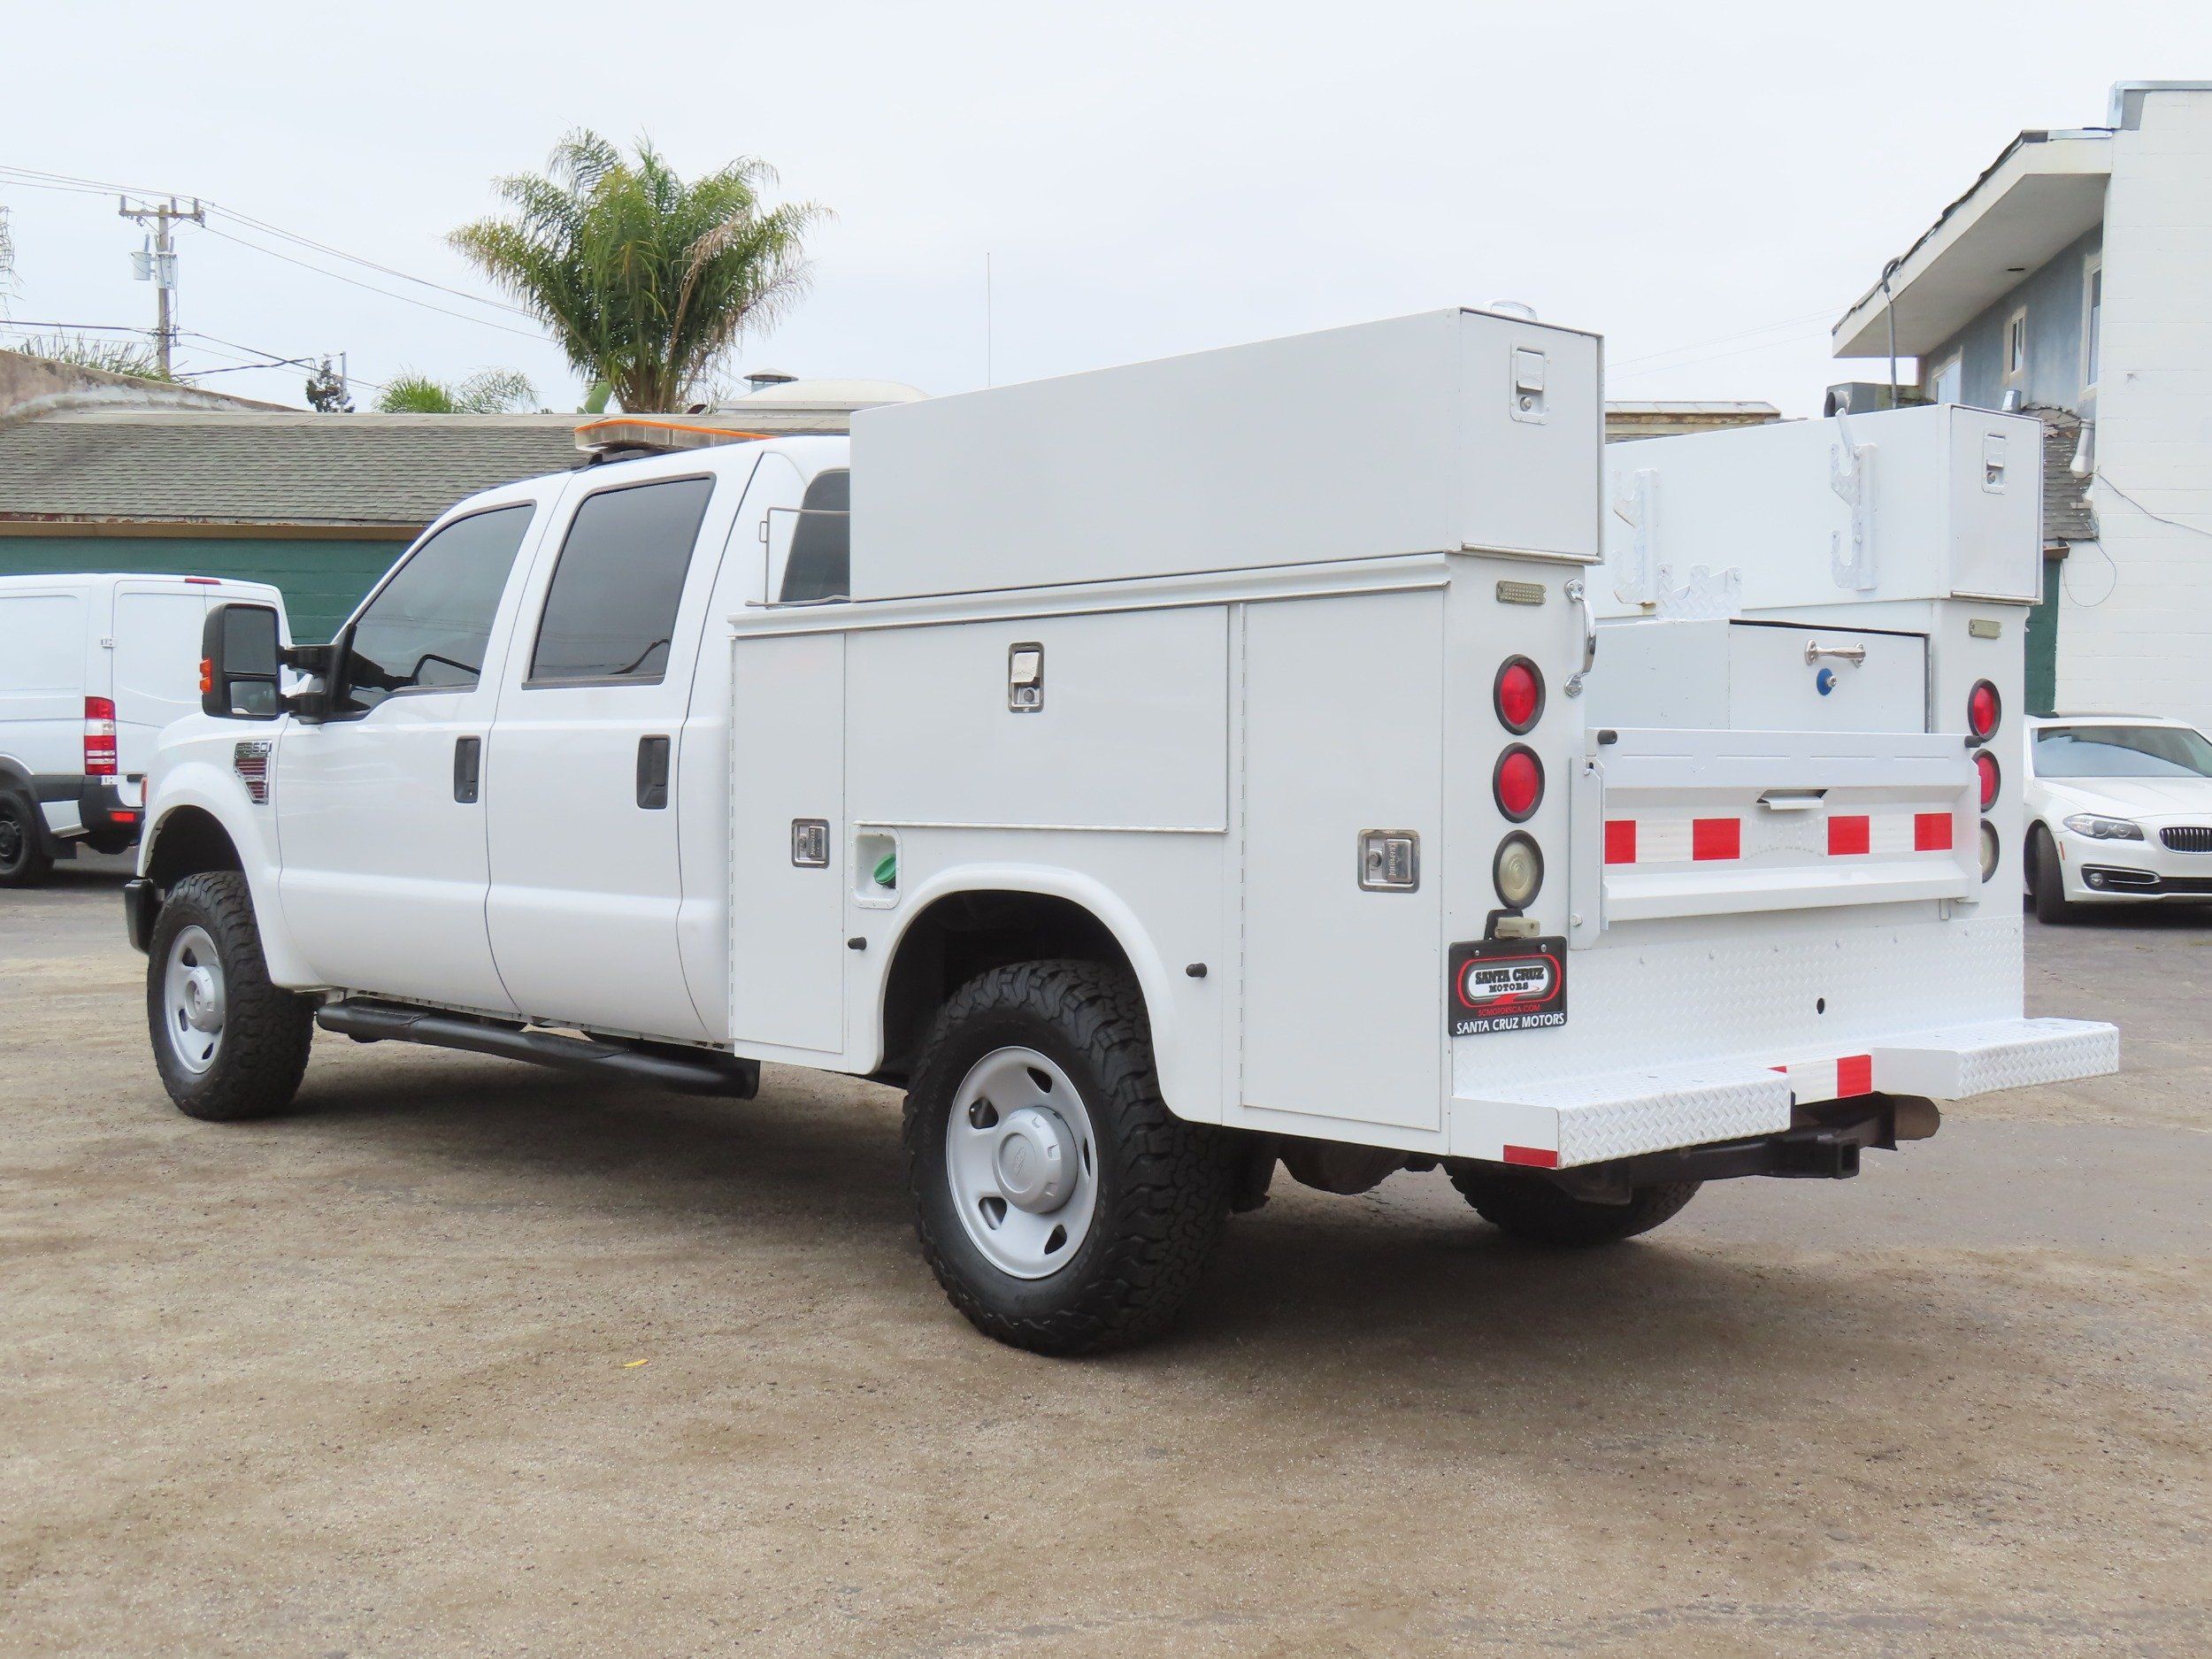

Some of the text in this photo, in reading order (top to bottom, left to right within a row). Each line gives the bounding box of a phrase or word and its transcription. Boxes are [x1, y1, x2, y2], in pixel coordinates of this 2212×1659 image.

[1475, 968, 1544, 985] SANTA CRUZ
[1489, 982, 1529, 993] MOTORS
[1456, 1013, 1564, 1034] SANTA CRUZ MOTORS
